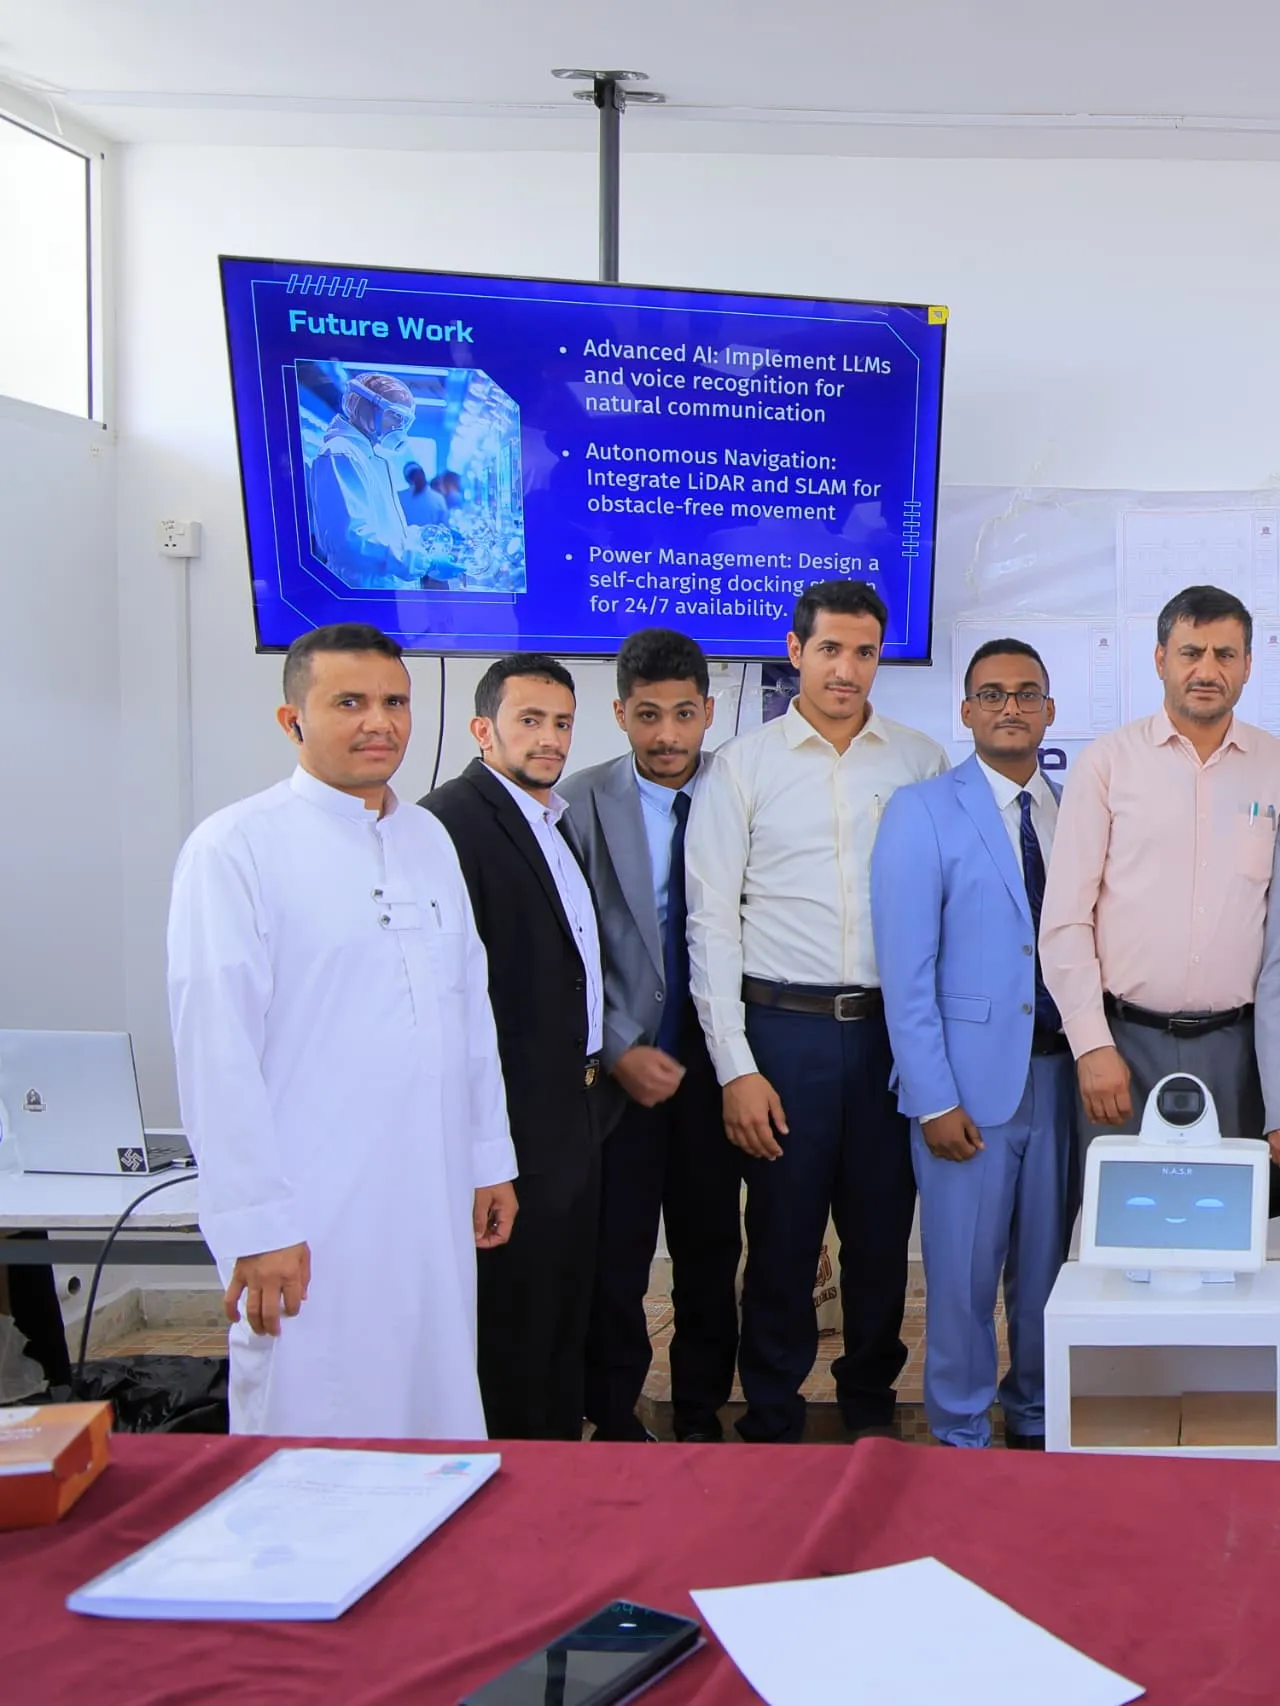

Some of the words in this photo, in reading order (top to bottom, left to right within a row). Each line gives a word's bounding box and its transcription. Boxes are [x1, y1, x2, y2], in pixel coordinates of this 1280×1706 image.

[288, 308, 390, 339] Future
[396, 315, 475, 344] Work
[583, 338, 687, 363] Advanced
[692, 345, 718, 364] AI:
[725, 346, 837, 372] Implement
[842, 354, 892, 375] LLMs
[584, 366, 624, 386] and
[630, 368, 686, 389] voice
[692, 373, 809, 397] recognition
[815, 378, 845, 398] for
[585, 395, 662, 415] natural
[667, 399, 826, 423] communication
[585, 441, 718, 466] Autonomous
[724, 448, 837, 473] Navigation:
[586, 468, 682, 493] Integrate
[687, 471, 746, 492] LiDAR
[751, 475, 790, 494] and
[794, 477, 848, 497] SLAM
[851, 479, 882, 498] for
[587, 493, 725, 517] obstacle-free
[731, 502, 837, 522] movement
[588, 545, 653, 565] Power
[657, 547, 793, 572] Management:
[798, 552, 862, 574] Design
[868, 557, 880, 572] a
[588, 570, 722, 596] self-charging
[727, 574, 805, 598] docking
[589, 594, 620, 614] for
[624, 595, 670, 617] 24/7
[674, 598, 788, 622] availability.
